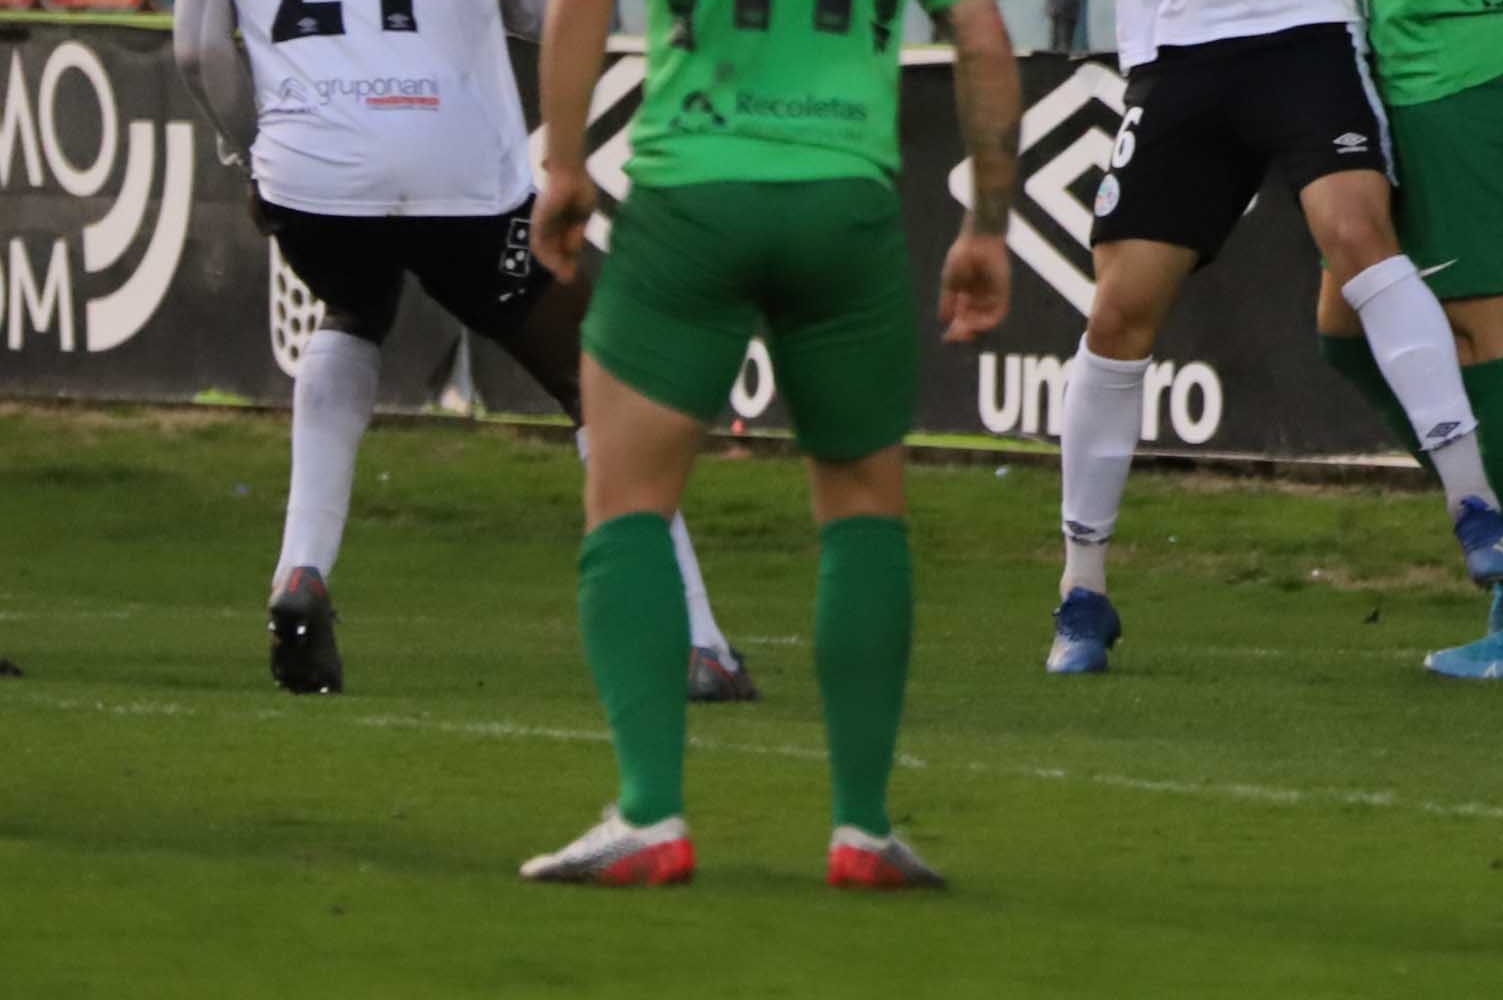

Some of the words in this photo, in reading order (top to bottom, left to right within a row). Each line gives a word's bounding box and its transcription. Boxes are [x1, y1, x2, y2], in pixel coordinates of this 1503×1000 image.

[1111, 106, 1144, 168] 6
[0, 237, 75, 352] M
[979, 352, 1223, 444] umro
